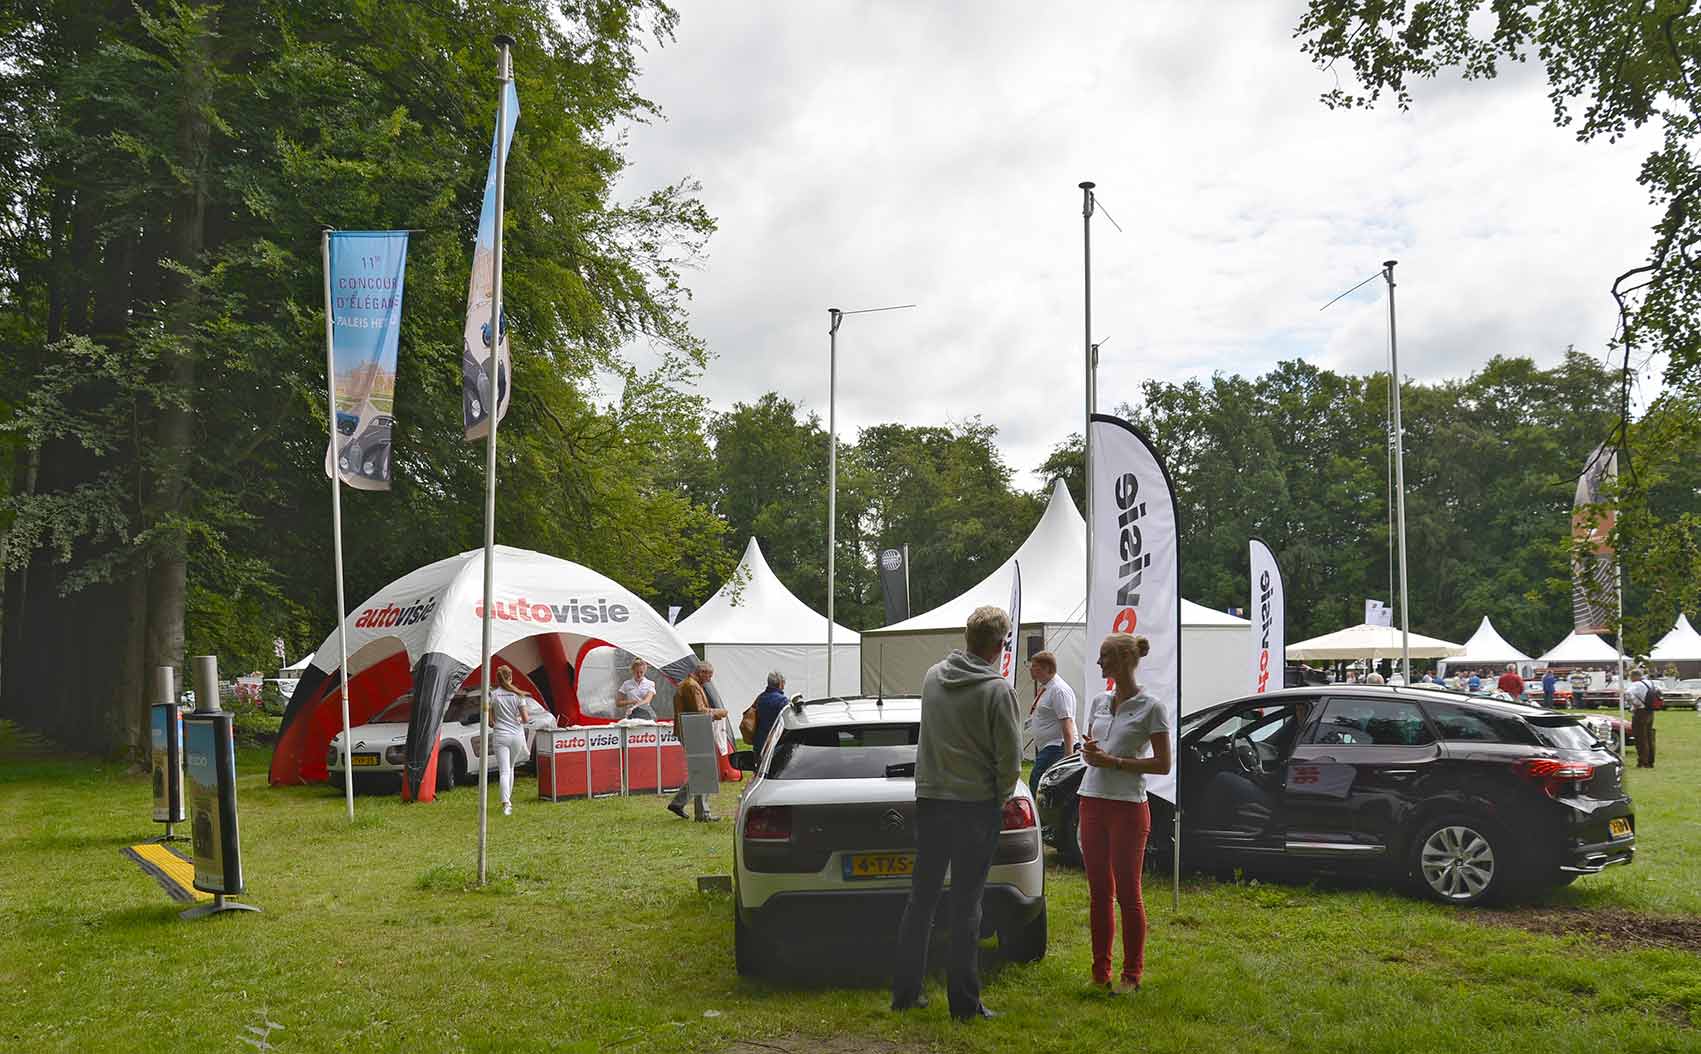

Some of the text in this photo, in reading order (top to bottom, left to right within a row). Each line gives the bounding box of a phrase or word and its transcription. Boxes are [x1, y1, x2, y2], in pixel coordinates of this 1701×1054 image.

[338, 278, 398, 289] CONCOUR
[355, 597, 435, 628] autovisie
[475, 598, 630, 624] autovisie
[661, 730, 678, 742] vis
